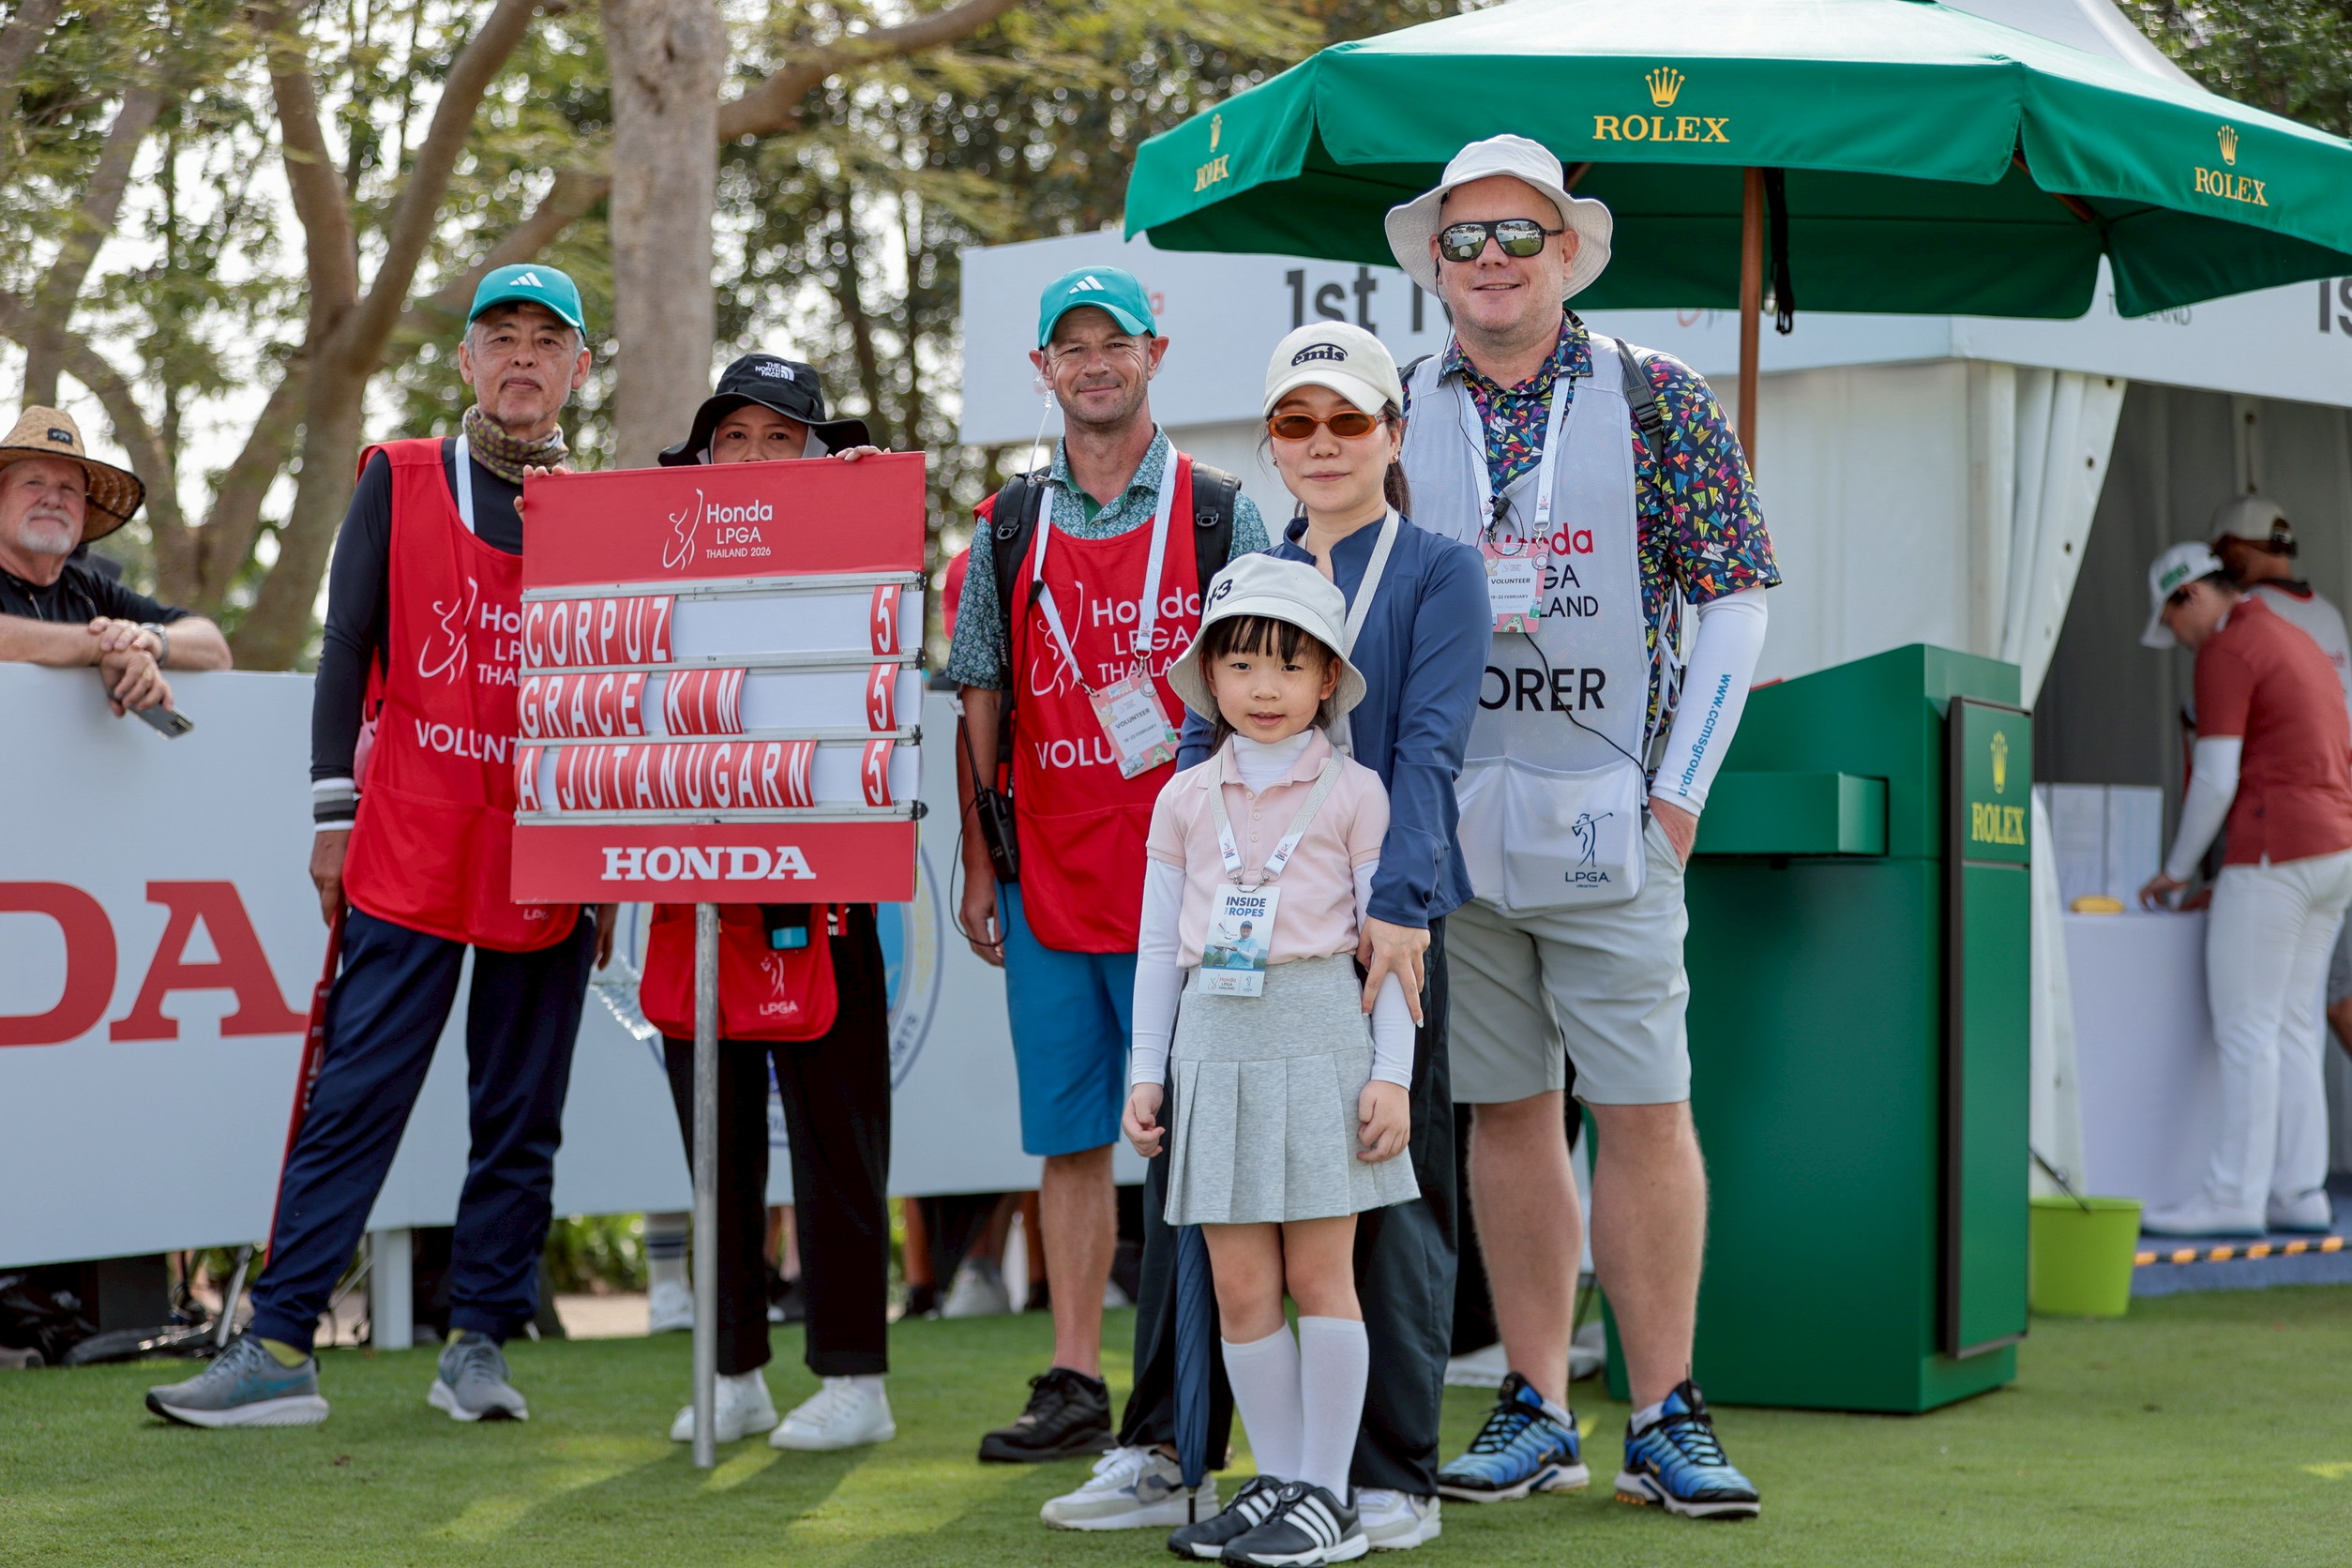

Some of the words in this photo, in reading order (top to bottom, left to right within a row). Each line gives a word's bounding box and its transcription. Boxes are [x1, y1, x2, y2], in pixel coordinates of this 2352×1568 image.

[1592, 113, 1730, 143] ROLEX
[2194, 166, 2269, 207] ROLEX
[1291, 346, 1345, 367] emis
[755, 366, 780, 374] NORTH
[706, 499, 773, 524] Honda
[716, 526, 761, 544] LPGA
[705, 548, 748, 559] THAILAND
[750, 547, 771, 557] 2026
[1543, 564, 1580, 590] GA
[525, 596, 670, 668] CORPUZ
[876, 586, 895, 654] 5
[494, 638, 521, 662] LP
[1478, 665, 1606, 712] ORER
[520, 672, 642, 739] GRACE
[667, 670, 743, 734] KIM
[872, 664, 892, 731] 5
[1115, 707, 1151, 730] VOLUNTEER
[415, 717, 520, 765] VOLUNT
[520, 746, 541, 810] A
[561, 742, 811, 809] JUTANUGARN
[867, 739, 888, 806] 5
[1971, 802, 2026, 845] ROLEX
[600, 846, 817, 882] HONDA
[1565, 871, 1610, 882] LPGA
[1226, 896, 1267, 908] INSIDE
[1229, 907, 1264, 917] ROPES
[759, 1000, 798, 1015] LPGA
